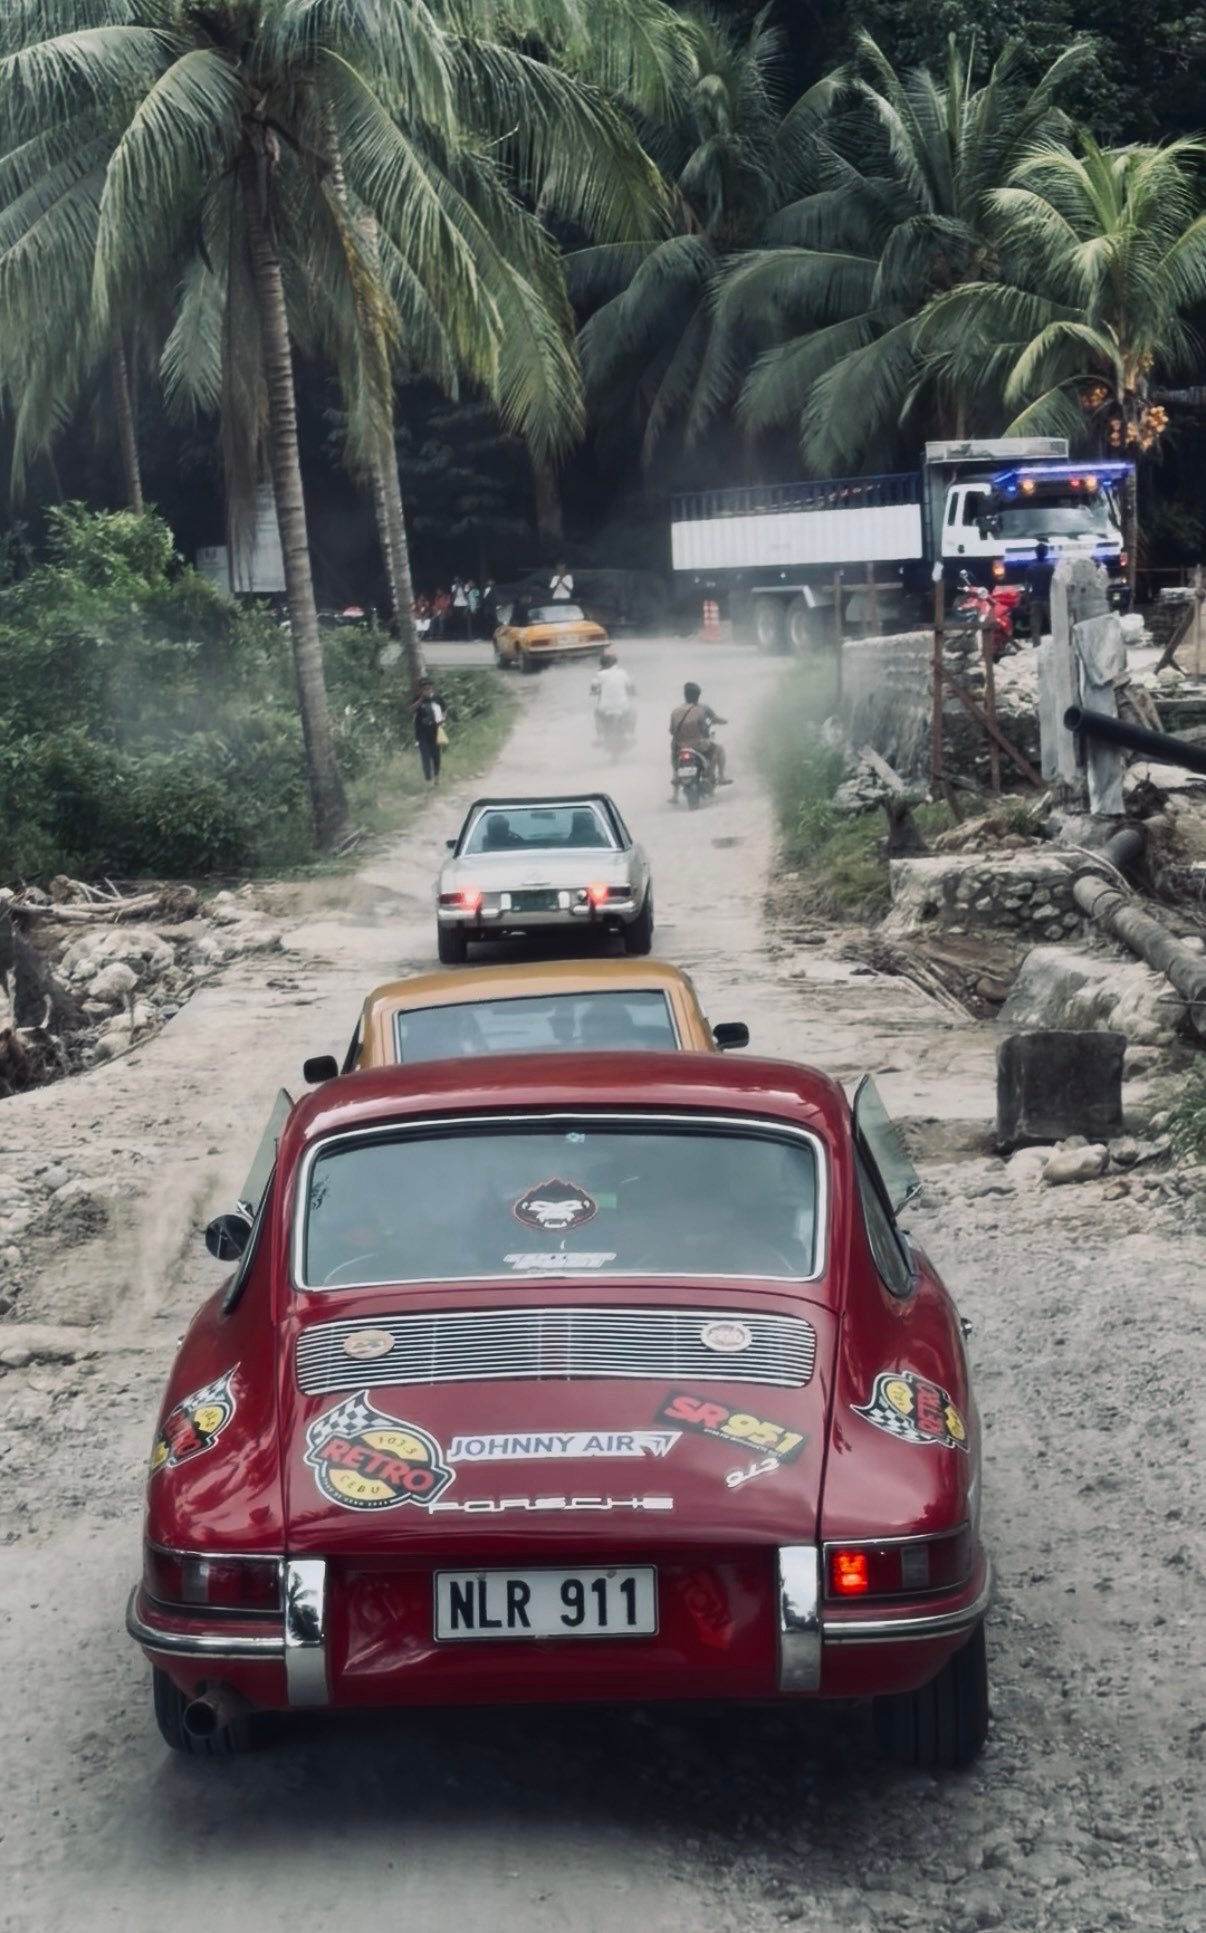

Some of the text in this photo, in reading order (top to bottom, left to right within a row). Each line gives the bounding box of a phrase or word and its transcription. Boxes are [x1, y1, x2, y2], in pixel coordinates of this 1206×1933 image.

[450, 1435, 635, 1457] JOHNNY AIR
[319, 1438, 434, 1492] RETRO
[340, 1474, 381, 1494] CEBU
[428, 1496, 673, 1514] PORSCHE
[449, 1577, 637, 1630] NLR 911
